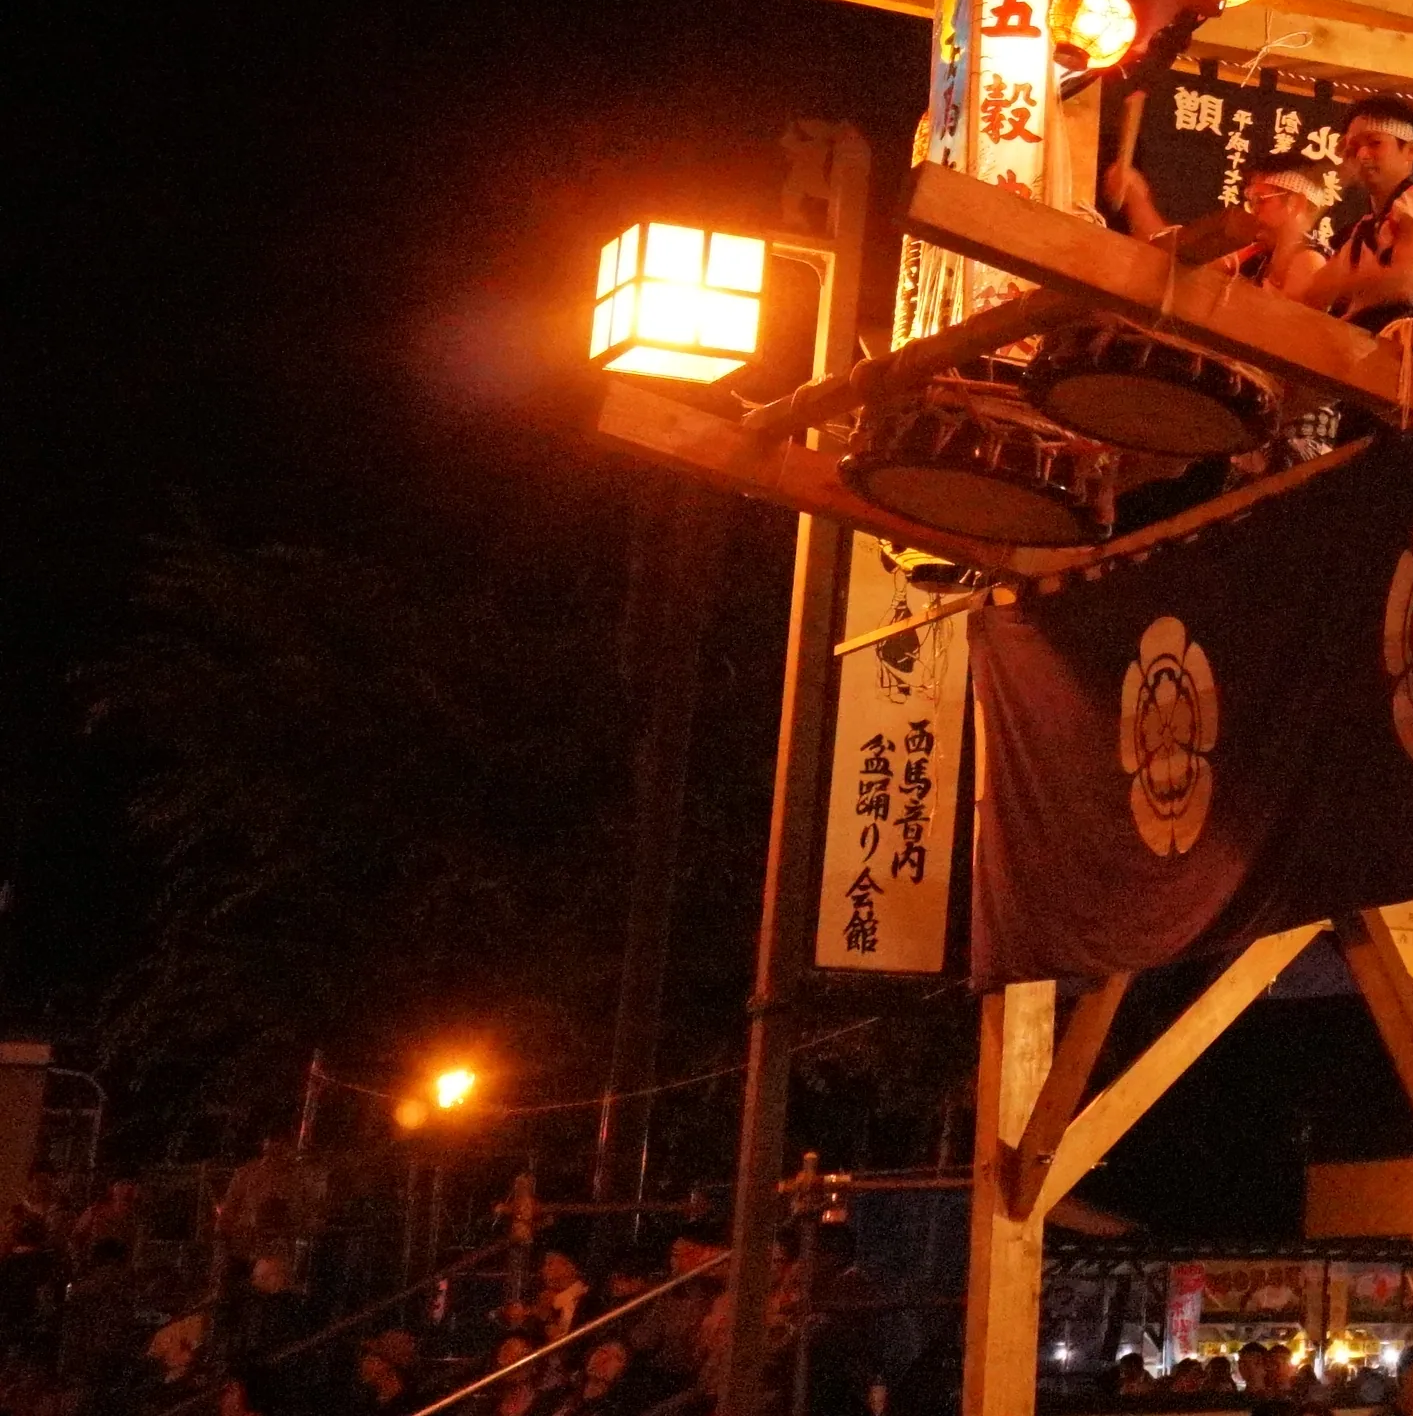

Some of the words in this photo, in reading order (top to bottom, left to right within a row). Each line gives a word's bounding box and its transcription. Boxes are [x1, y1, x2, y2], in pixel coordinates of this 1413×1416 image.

[844, 734, 895, 954] 盆踊り会館
[891, 719, 934, 884] 西馬音内
